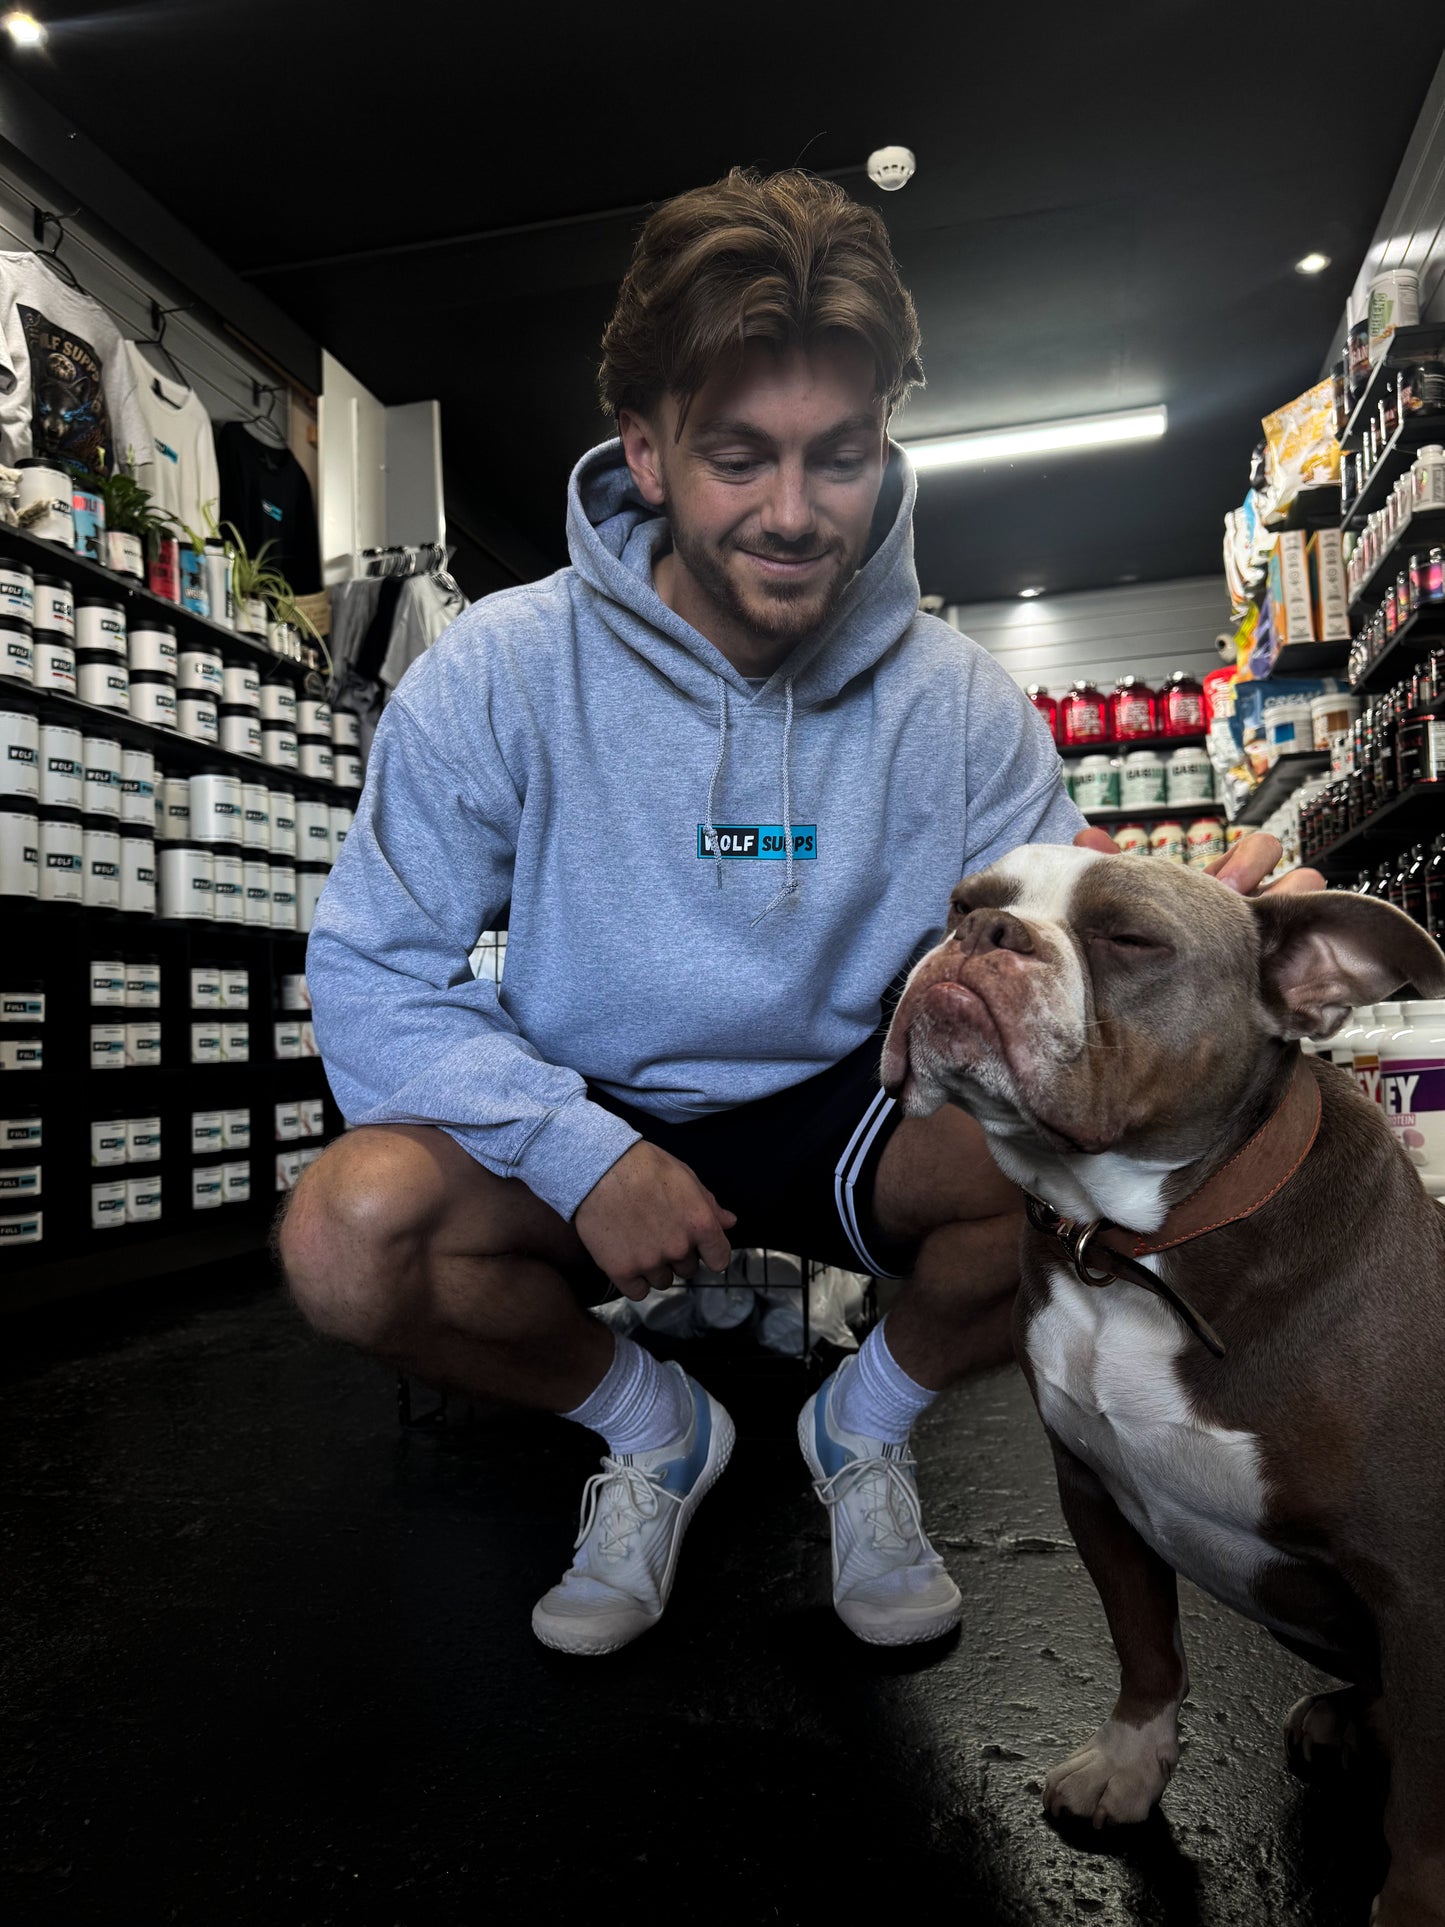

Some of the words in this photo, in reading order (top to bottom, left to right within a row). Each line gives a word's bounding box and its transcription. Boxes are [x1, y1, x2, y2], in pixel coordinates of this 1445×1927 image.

[1370, 293, 1387, 337] GREENS
[1, 584, 22, 595] WOLF
[10, 646, 28, 657] WOLF
[53, 660, 70, 671] WOLF
[11, 748, 32, 760] WOLF
[51, 760, 72, 771] WOLF
[88, 771, 109, 781] WOLF
[217, 804, 233, 813] WOLF
[49, 856, 72, 867] WOLF
[95, 864, 114, 875] WOLF
[217, 885, 234, 893] WOLF
[19, 1051, 35, 1059] FULL
[1382, 1074, 1420, 1115] EY
[10, 1130, 27, 1138] FULL
[0, 1226, 18, 1234] FULL
